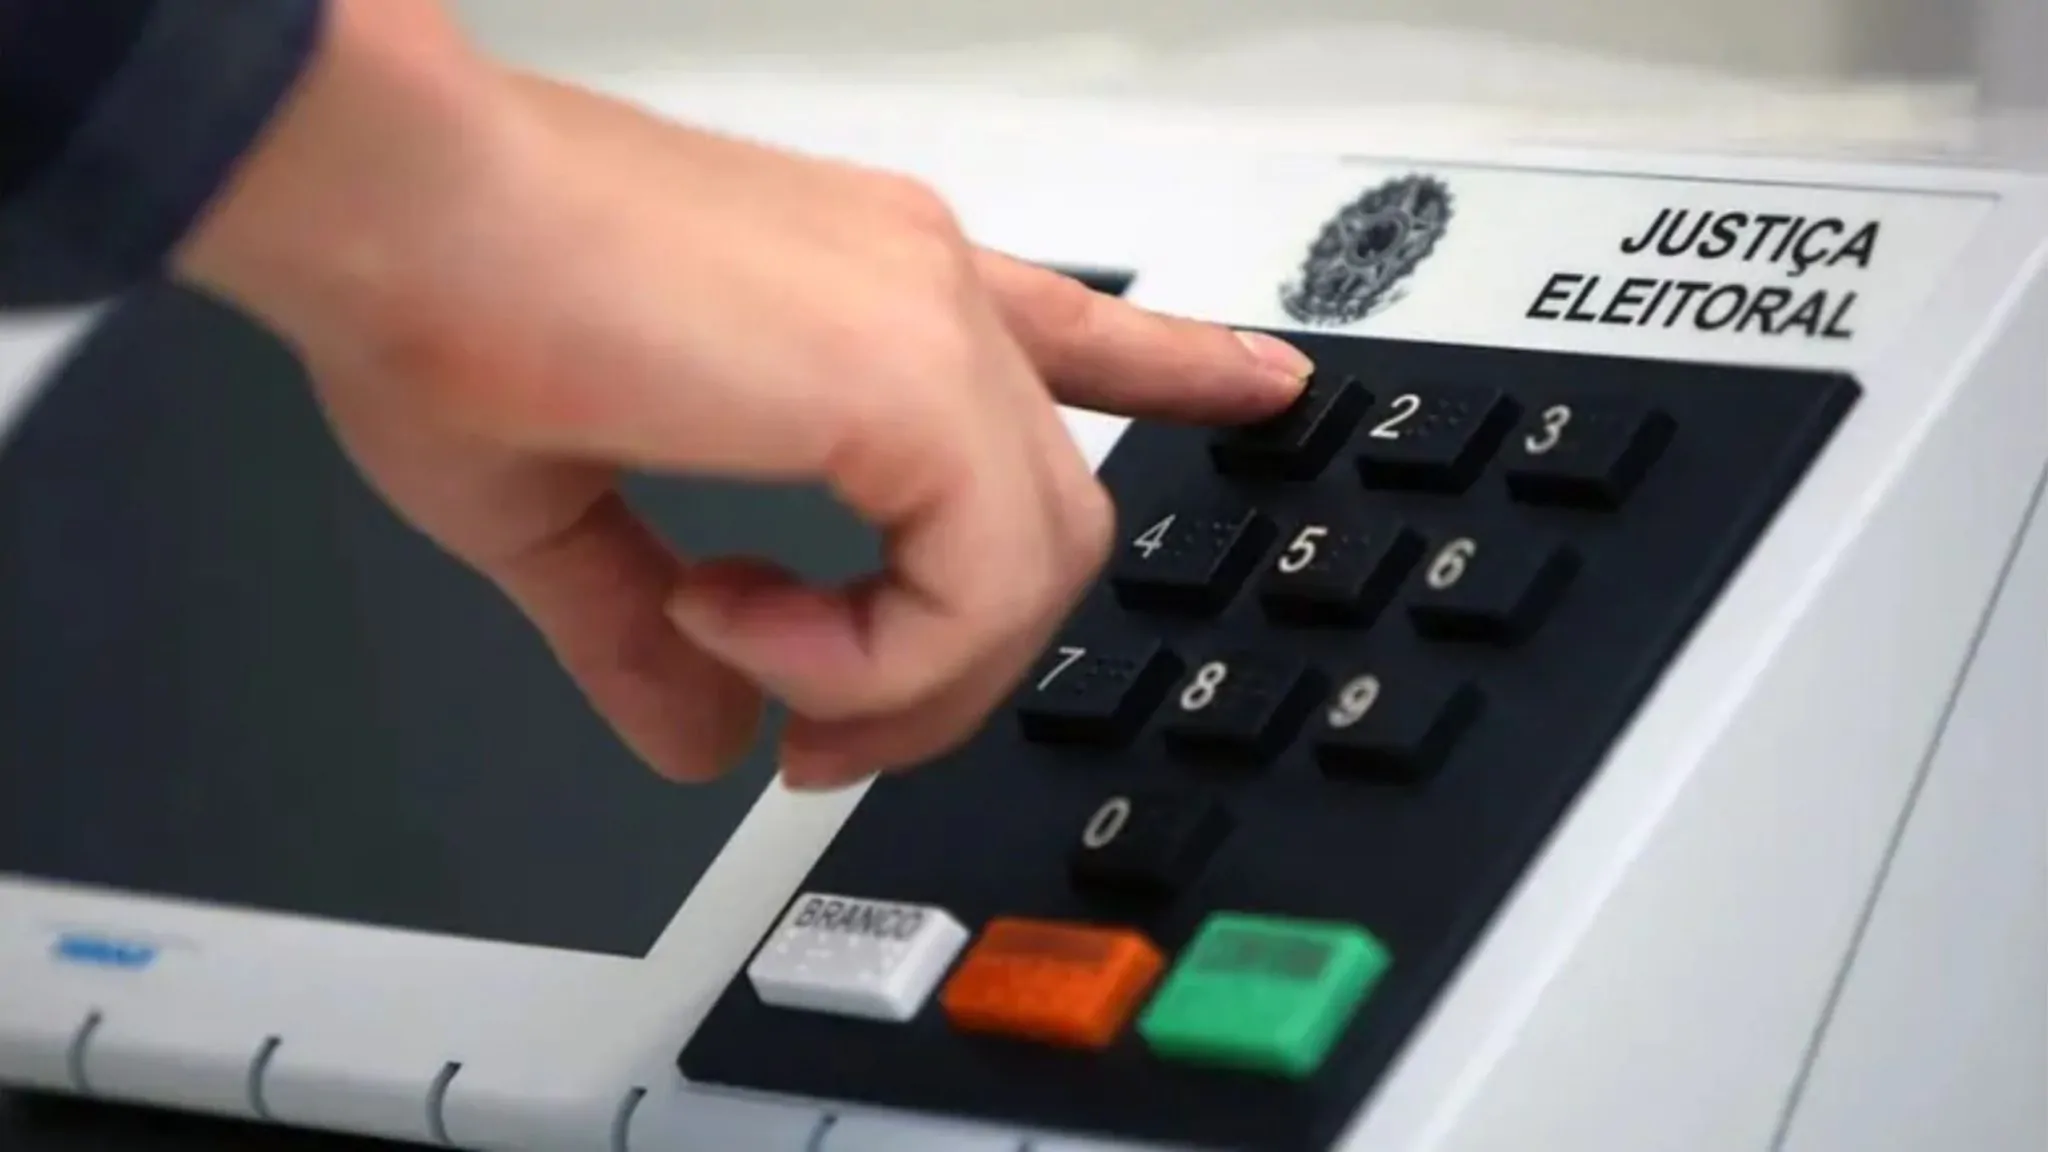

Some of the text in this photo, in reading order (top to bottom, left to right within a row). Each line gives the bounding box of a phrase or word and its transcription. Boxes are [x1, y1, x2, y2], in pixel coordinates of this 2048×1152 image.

[1620, 208, 1880, 276] JUSTIÇA
[1526, 273, 1858, 339] ELEITORAL
[1370, 394, 1421, 440] 2
[1525, 405, 1570, 453] 3
[1134, 514, 1176, 558] 4
[1278, 527, 1326, 572] 5
[1426, 538, 1475, 589] 6
[1037, 647, 1086, 691] 7
[1180, 661, 1226, 709] 8
[1327, 675, 1379, 727] 9
[1083, 797, 1130, 847] 0
[794, 898, 925, 939] BRANCO
